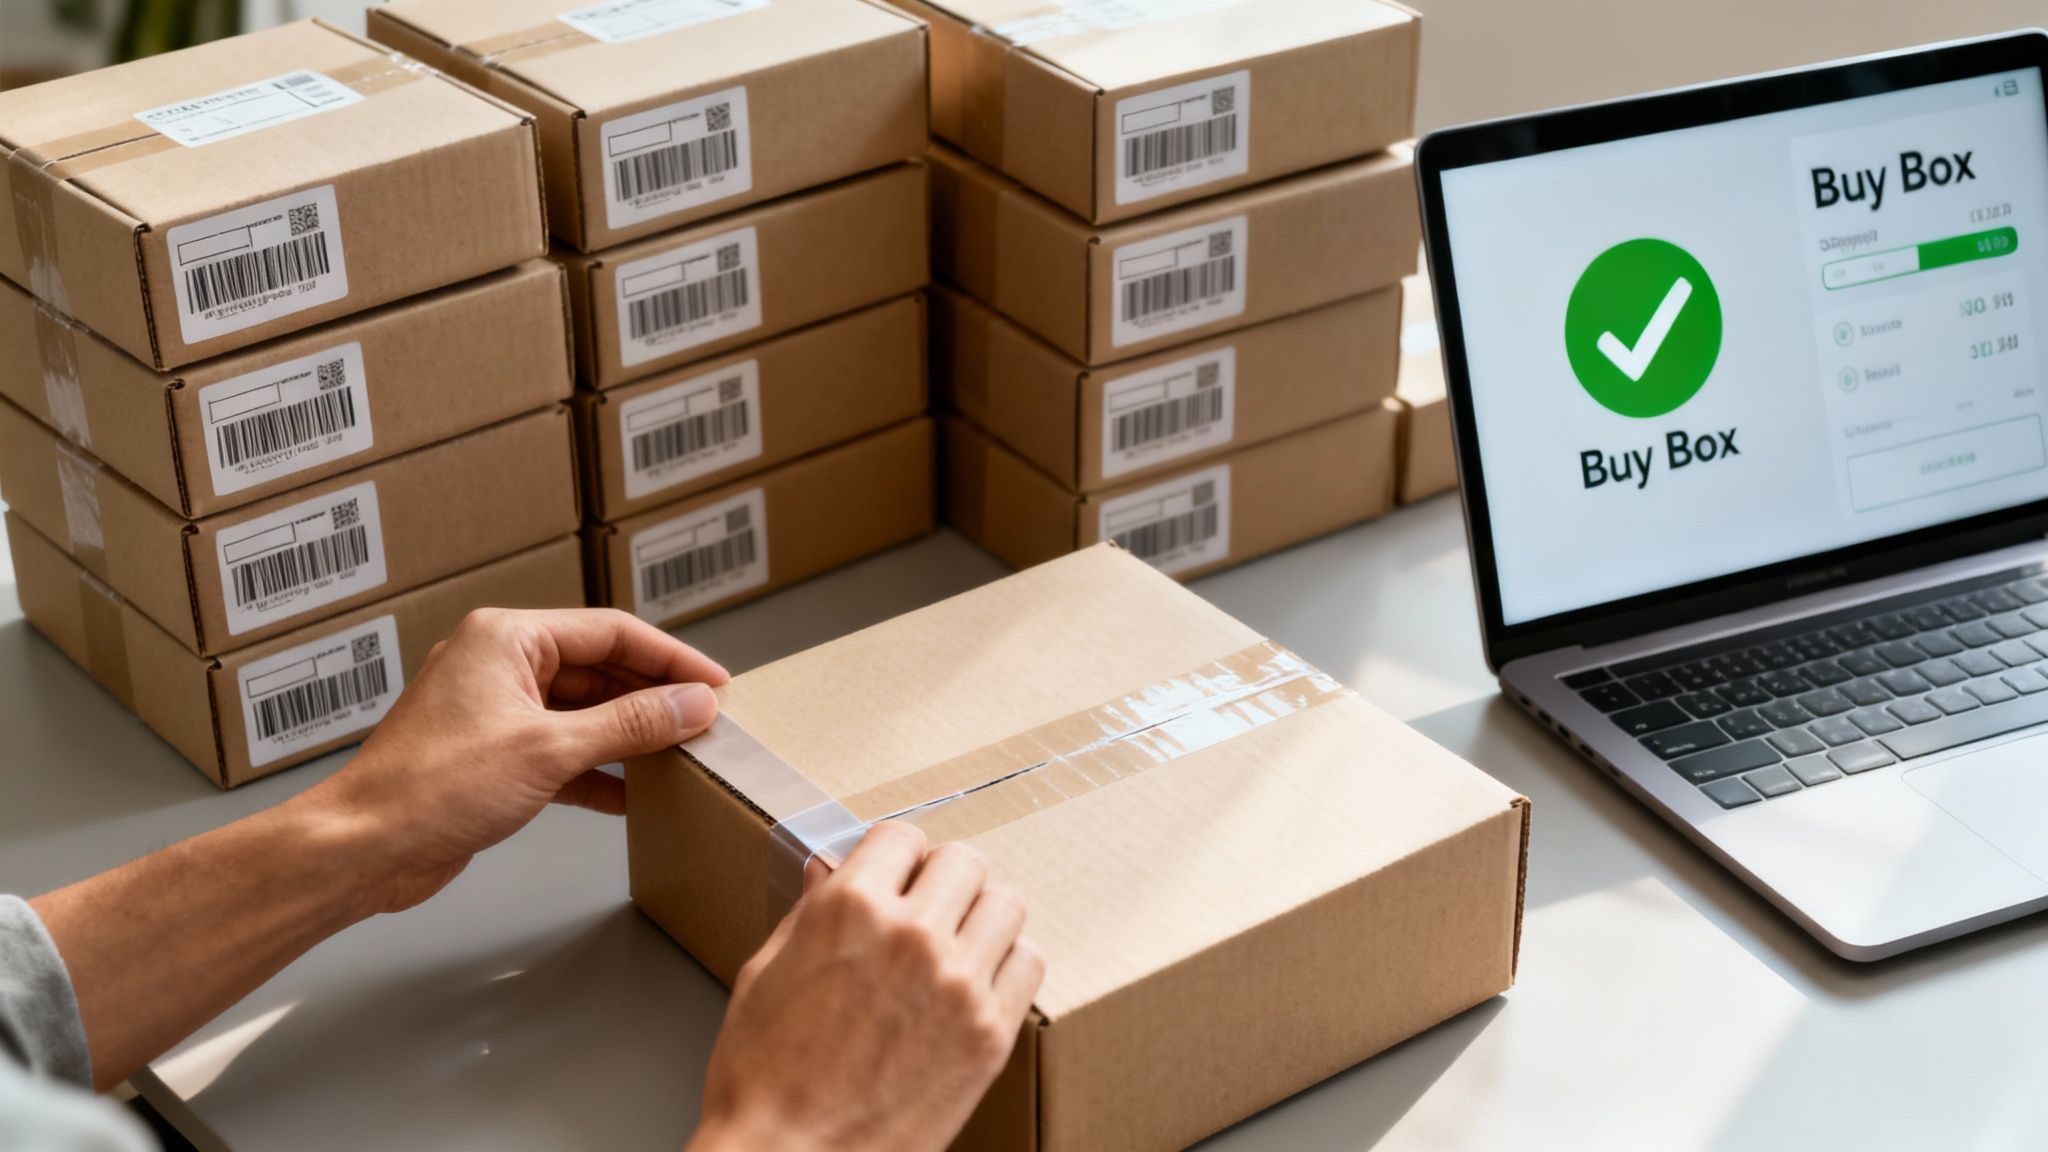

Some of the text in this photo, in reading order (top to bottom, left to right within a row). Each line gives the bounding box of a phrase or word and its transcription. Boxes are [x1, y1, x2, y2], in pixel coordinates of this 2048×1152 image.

[1812, 151, 1975, 211] Buy Box
[1581, 429, 1739, 489] Buy Box
